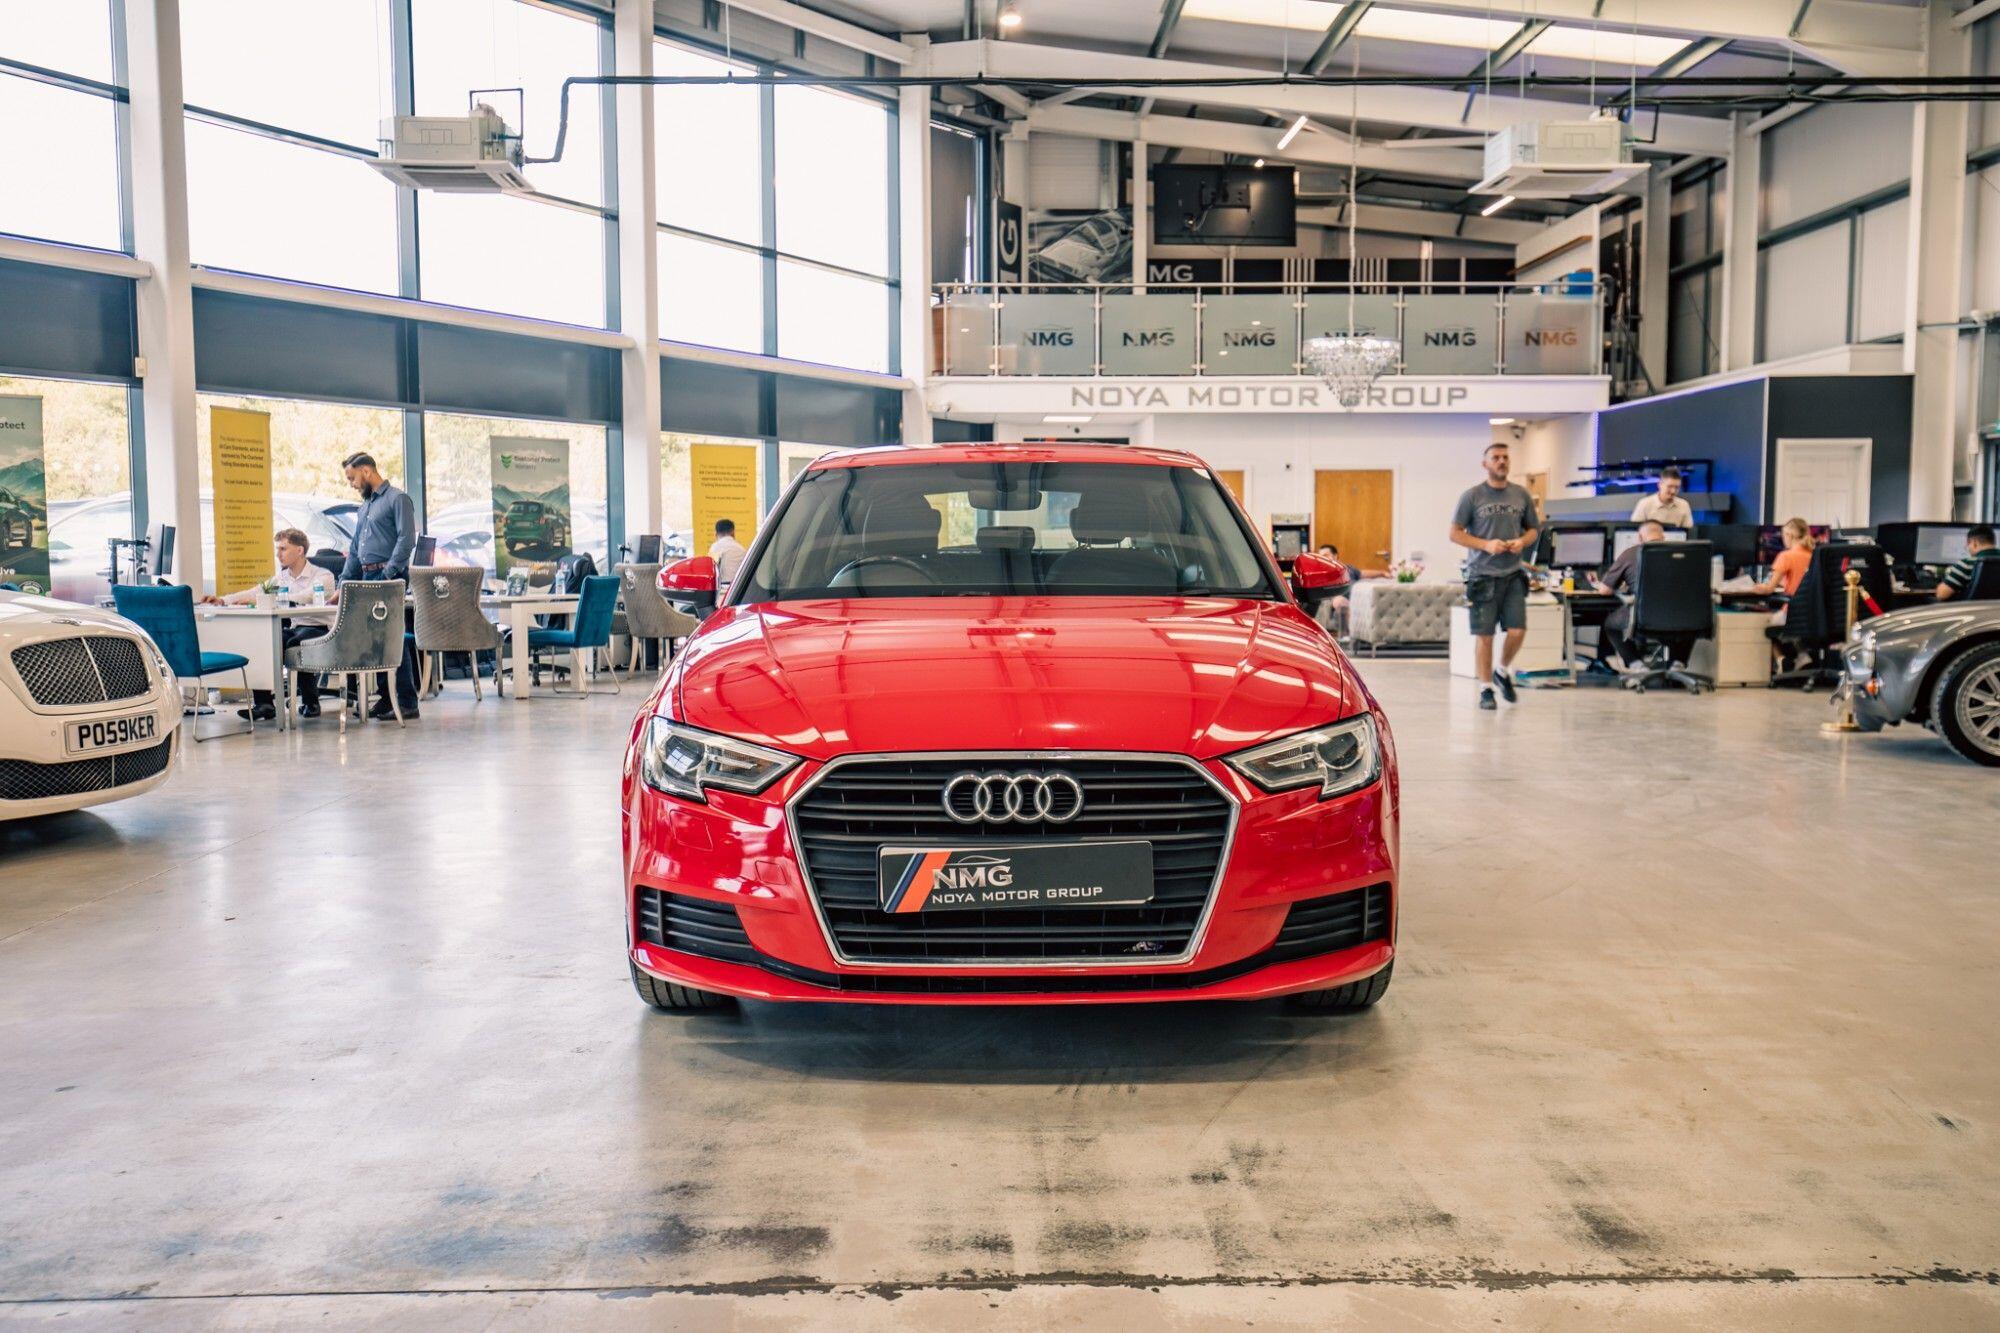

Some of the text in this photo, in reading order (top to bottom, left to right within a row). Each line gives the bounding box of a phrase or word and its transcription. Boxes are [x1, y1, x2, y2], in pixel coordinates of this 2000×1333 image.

[1021, 331, 1074, 347] NMG
[1122, 331, 1175, 347] NMG
[1224, 331, 1276, 347] NMG
[1424, 332, 1476, 347] NMG
[1525, 331, 1578, 347] NMG
[1071, 386, 1170, 406] NOYA
[1187, 386, 1320, 407] MOTOR
[932, 866, 1013, 889] NMG
[932, 887, 1103, 905] NOYA MOTOR GROUP
